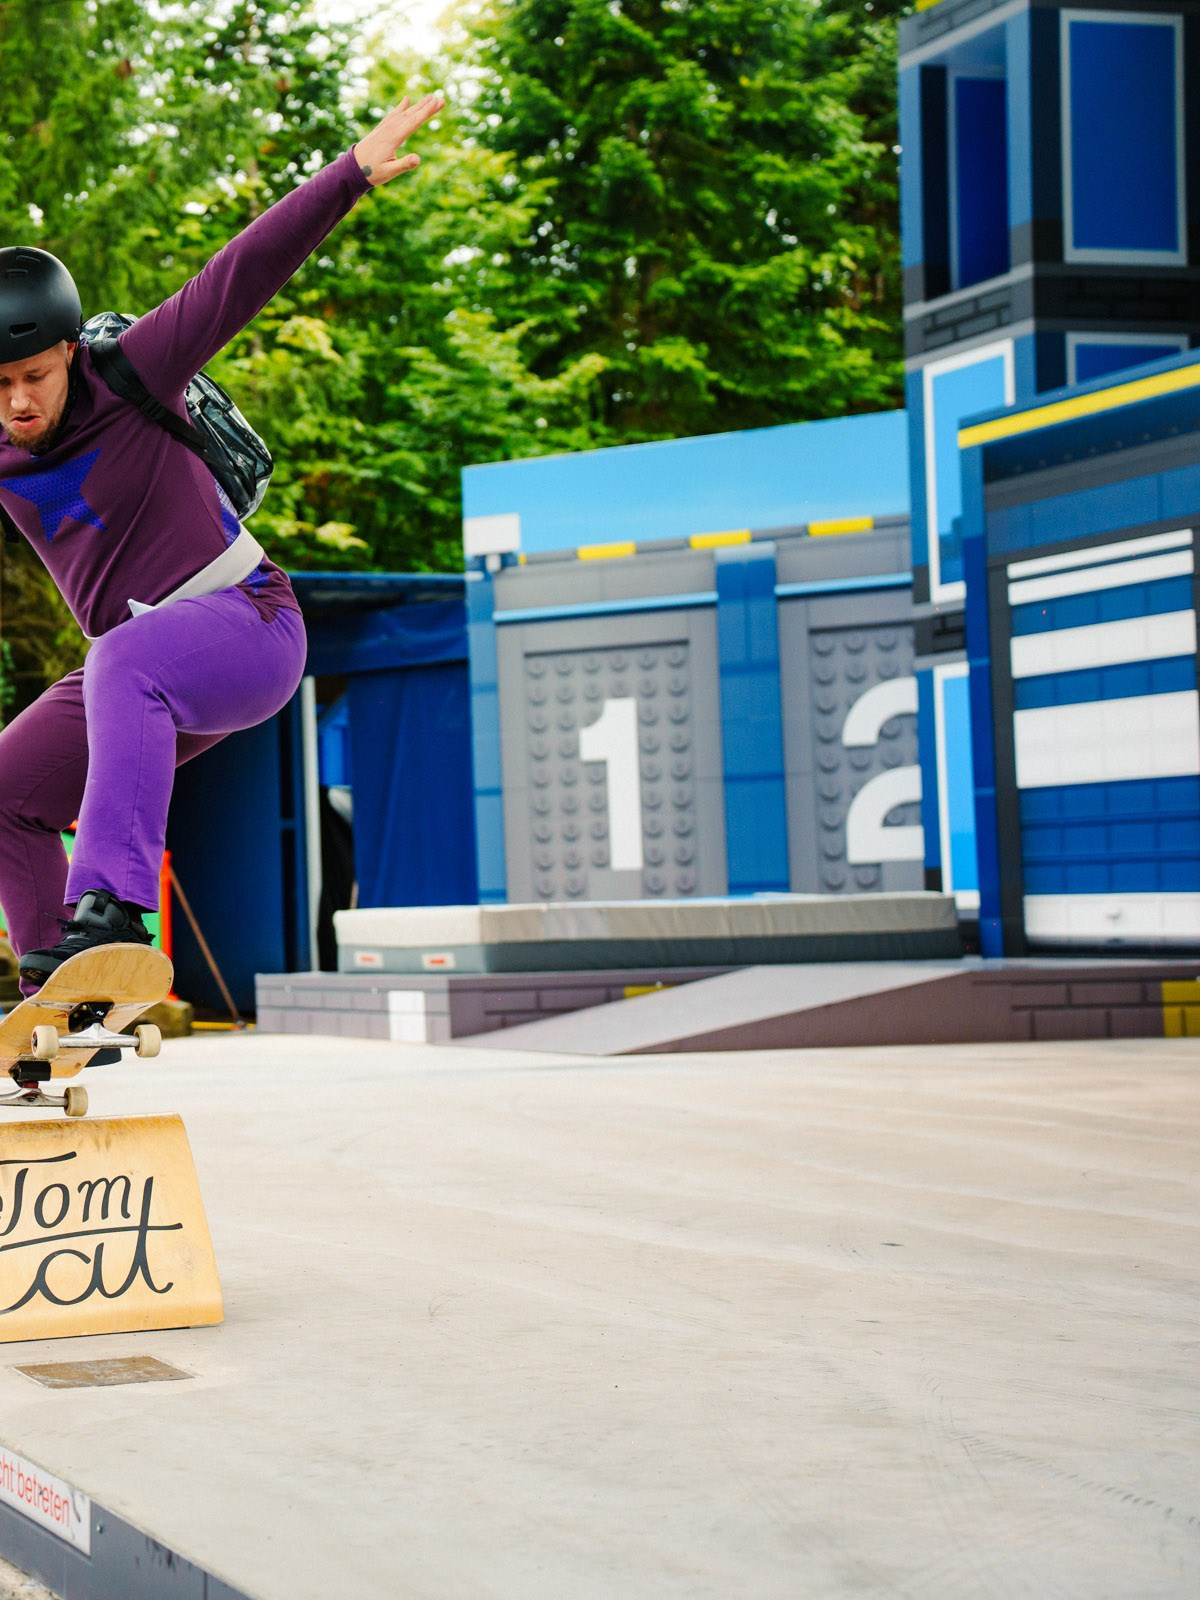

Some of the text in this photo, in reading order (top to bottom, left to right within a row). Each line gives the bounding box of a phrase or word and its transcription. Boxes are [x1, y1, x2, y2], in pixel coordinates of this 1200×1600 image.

[578, 697, 644, 872] 1
[841, 677, 923, 864] 2
[17, 1462, 71, 1528] betreten
